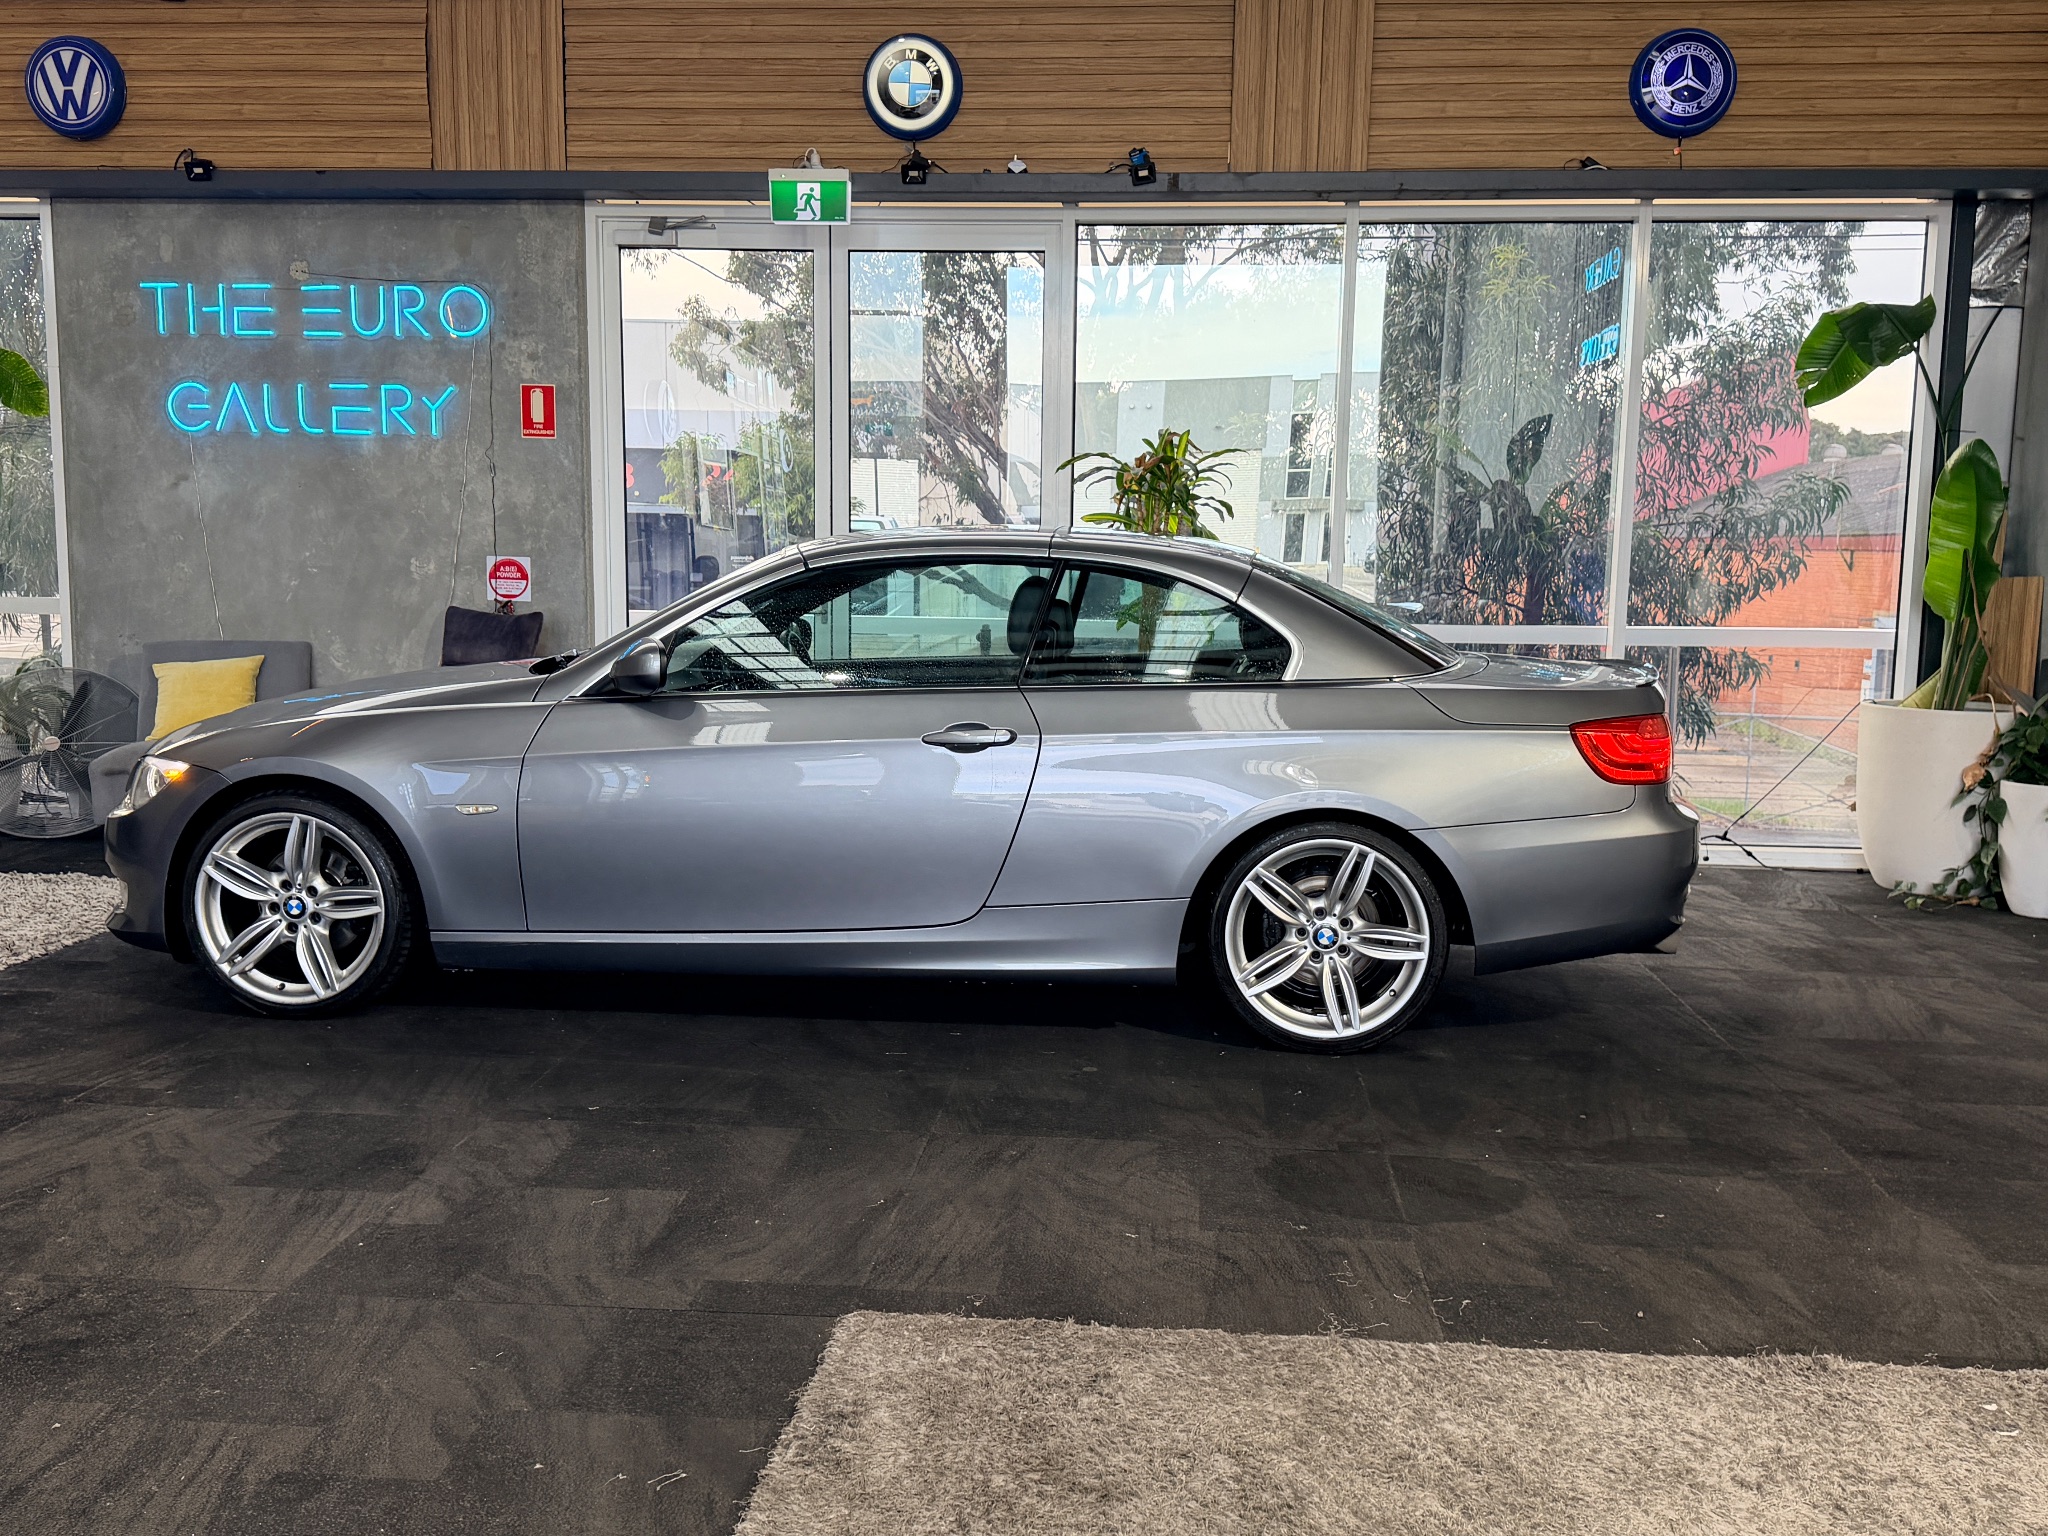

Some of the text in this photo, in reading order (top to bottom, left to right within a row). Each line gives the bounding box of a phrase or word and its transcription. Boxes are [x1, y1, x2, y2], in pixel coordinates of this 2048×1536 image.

[1663, 44, 1715, 62] MERCEDES
[1671, 103, 1699, 114] BENZ
[139, 282, 490, 338] THE EURO
[166, 380, 460, 437] GALLERY
